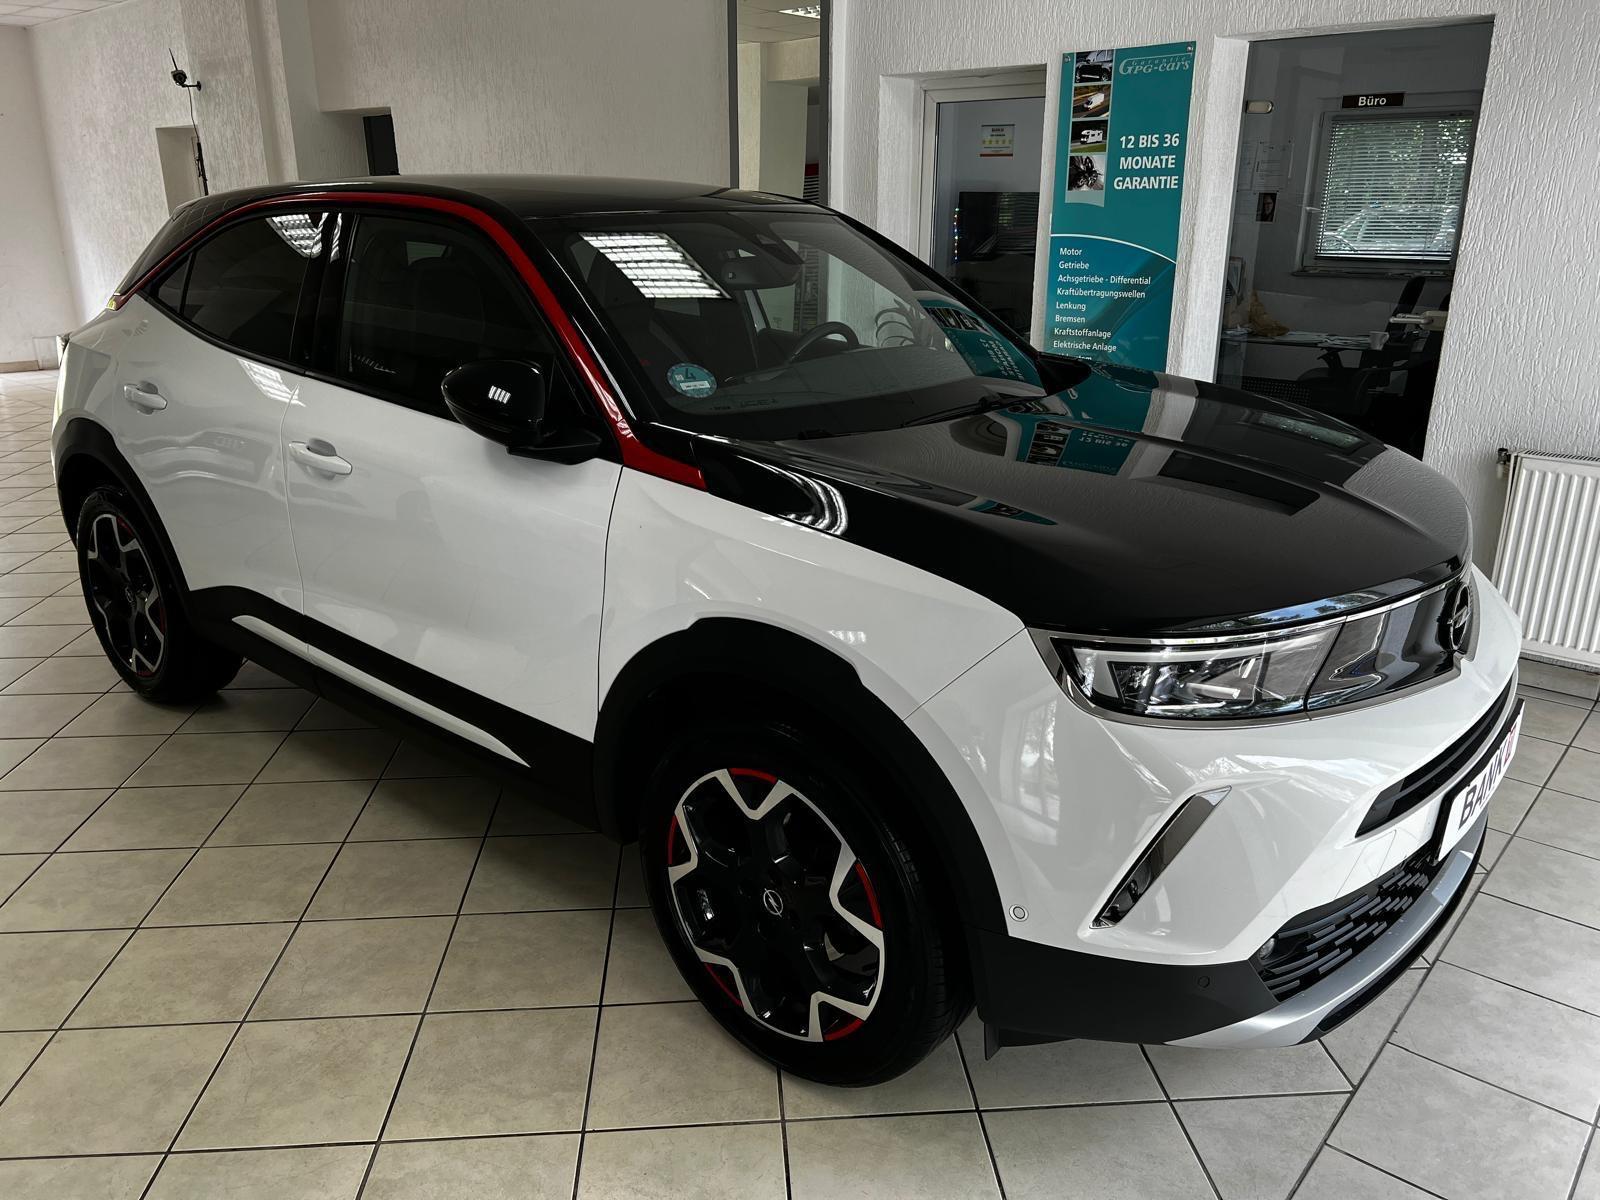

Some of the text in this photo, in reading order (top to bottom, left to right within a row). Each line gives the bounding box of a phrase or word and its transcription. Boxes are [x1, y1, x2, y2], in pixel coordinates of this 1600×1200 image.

[1358, 96, 1387, 107] Büro
[1119, 133, 1180, 149] 12 BIS 36
[1119, 155, 1176, 170] MONATE
[1113, 175, 1179, 190] GARANTIE
[1059, 247, 1083, 256] Motor
[1058, 260, 1090, 270] Getriebe
[1057, 274, 1104, 285] Achsgetriebe
[1110, 276, 1151, 285] Differential
[1056, 287, 1146, 299] Kraftübertragungswellen
[1056, 301, 1087, 312] Lenkung
[1055, 314, 1086, 323] Bremsen
[1054, 327, 1112, 338] Kraftstoffanlage
[1053, 340, 1117, 353] Elektrische Anlage
